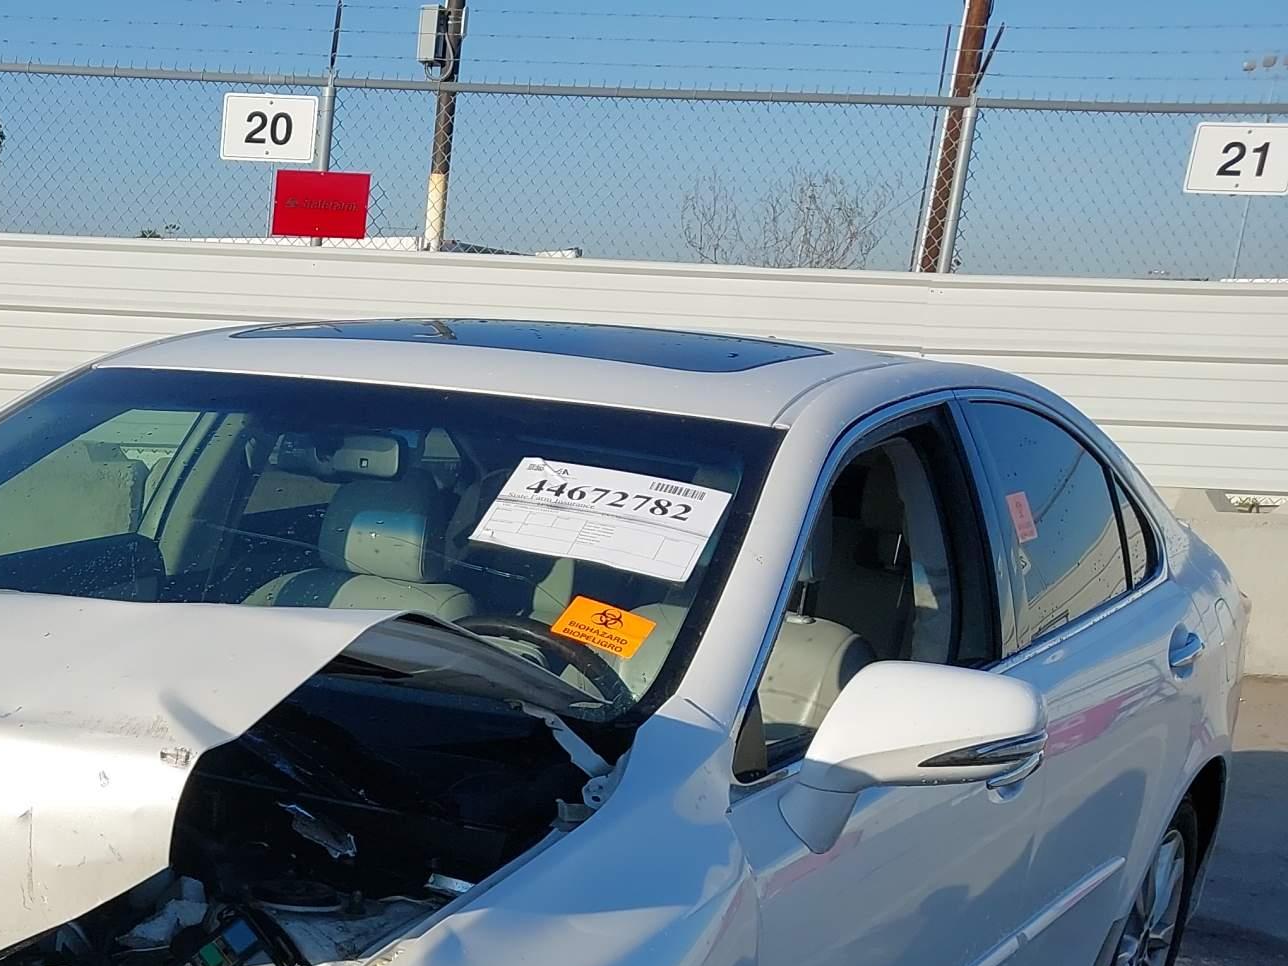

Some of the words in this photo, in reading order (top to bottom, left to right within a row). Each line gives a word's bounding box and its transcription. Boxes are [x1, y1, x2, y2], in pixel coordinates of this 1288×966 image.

[244, 111, 293, 146] 20
[1215, 141, 1270, 177] 21
[525, 479, 692, 521] 44672782
[562, 627, 623, 653] BIOPELIGRO
[567, 620, 628, 646] BIOHAZARD
